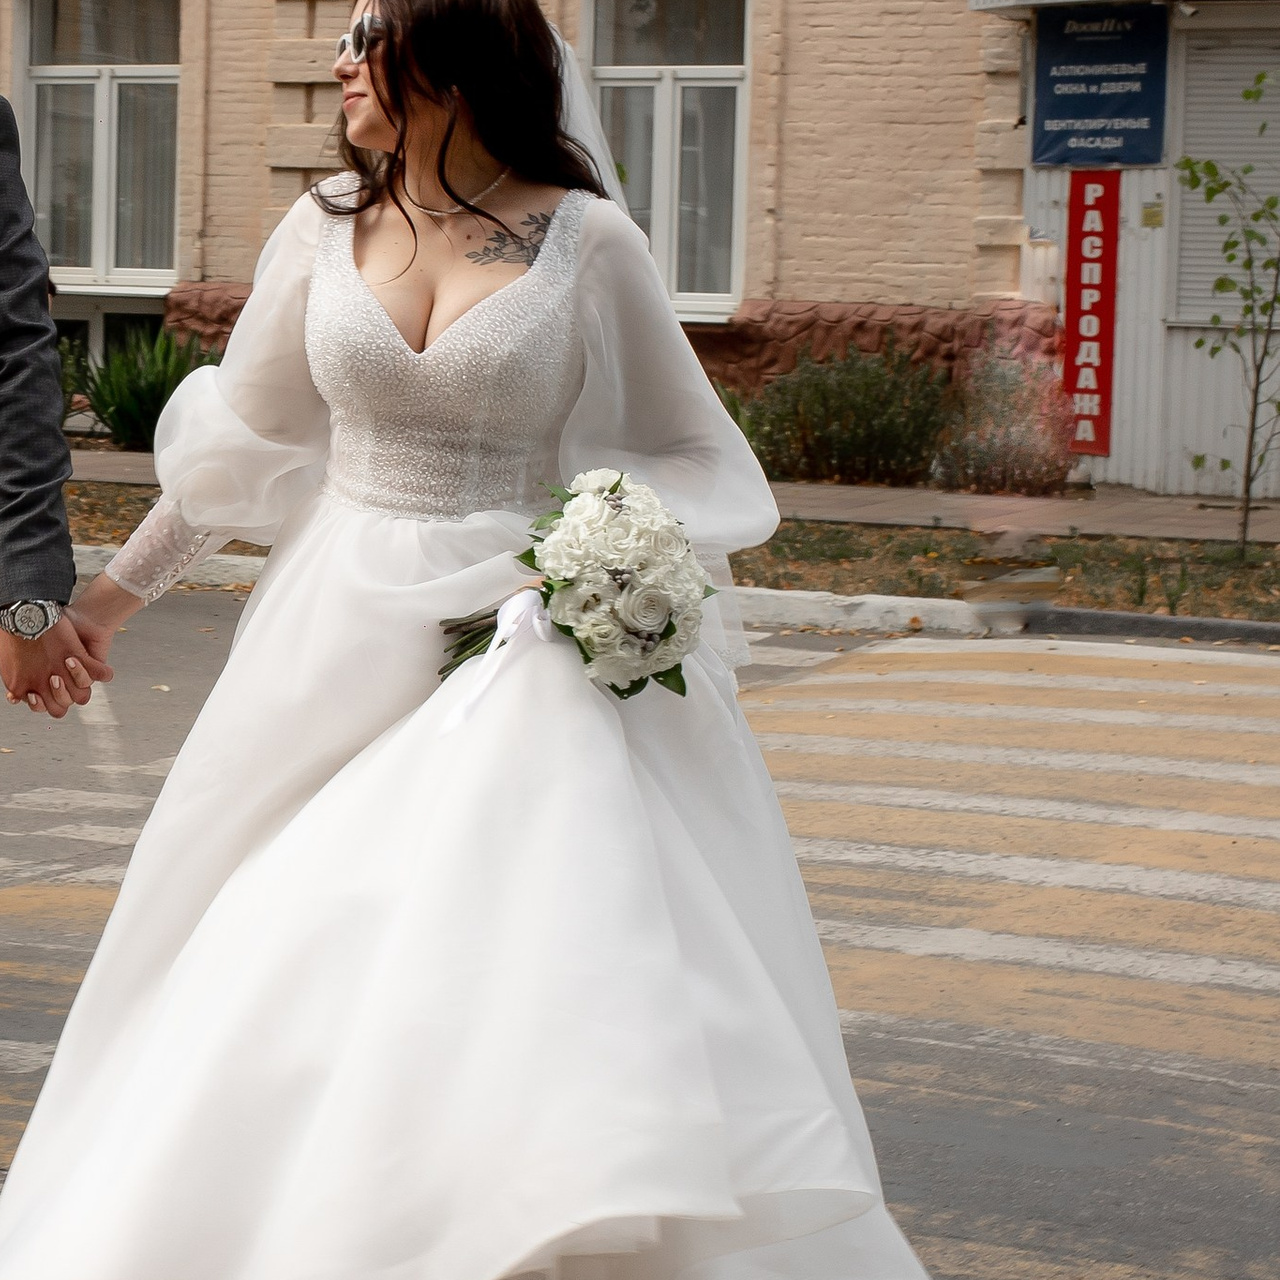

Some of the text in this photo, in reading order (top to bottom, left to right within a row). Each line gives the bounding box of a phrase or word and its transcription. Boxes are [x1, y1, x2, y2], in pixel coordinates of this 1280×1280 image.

[1054, 83, 1087, 94] ОКНА
[1099, 81, 1142, 95] ДВЕРИ
[1067, 136, 1123, 149] ФАСАДЫ
[1072, 183, 1105, 442] РАСПРОДАЖА
